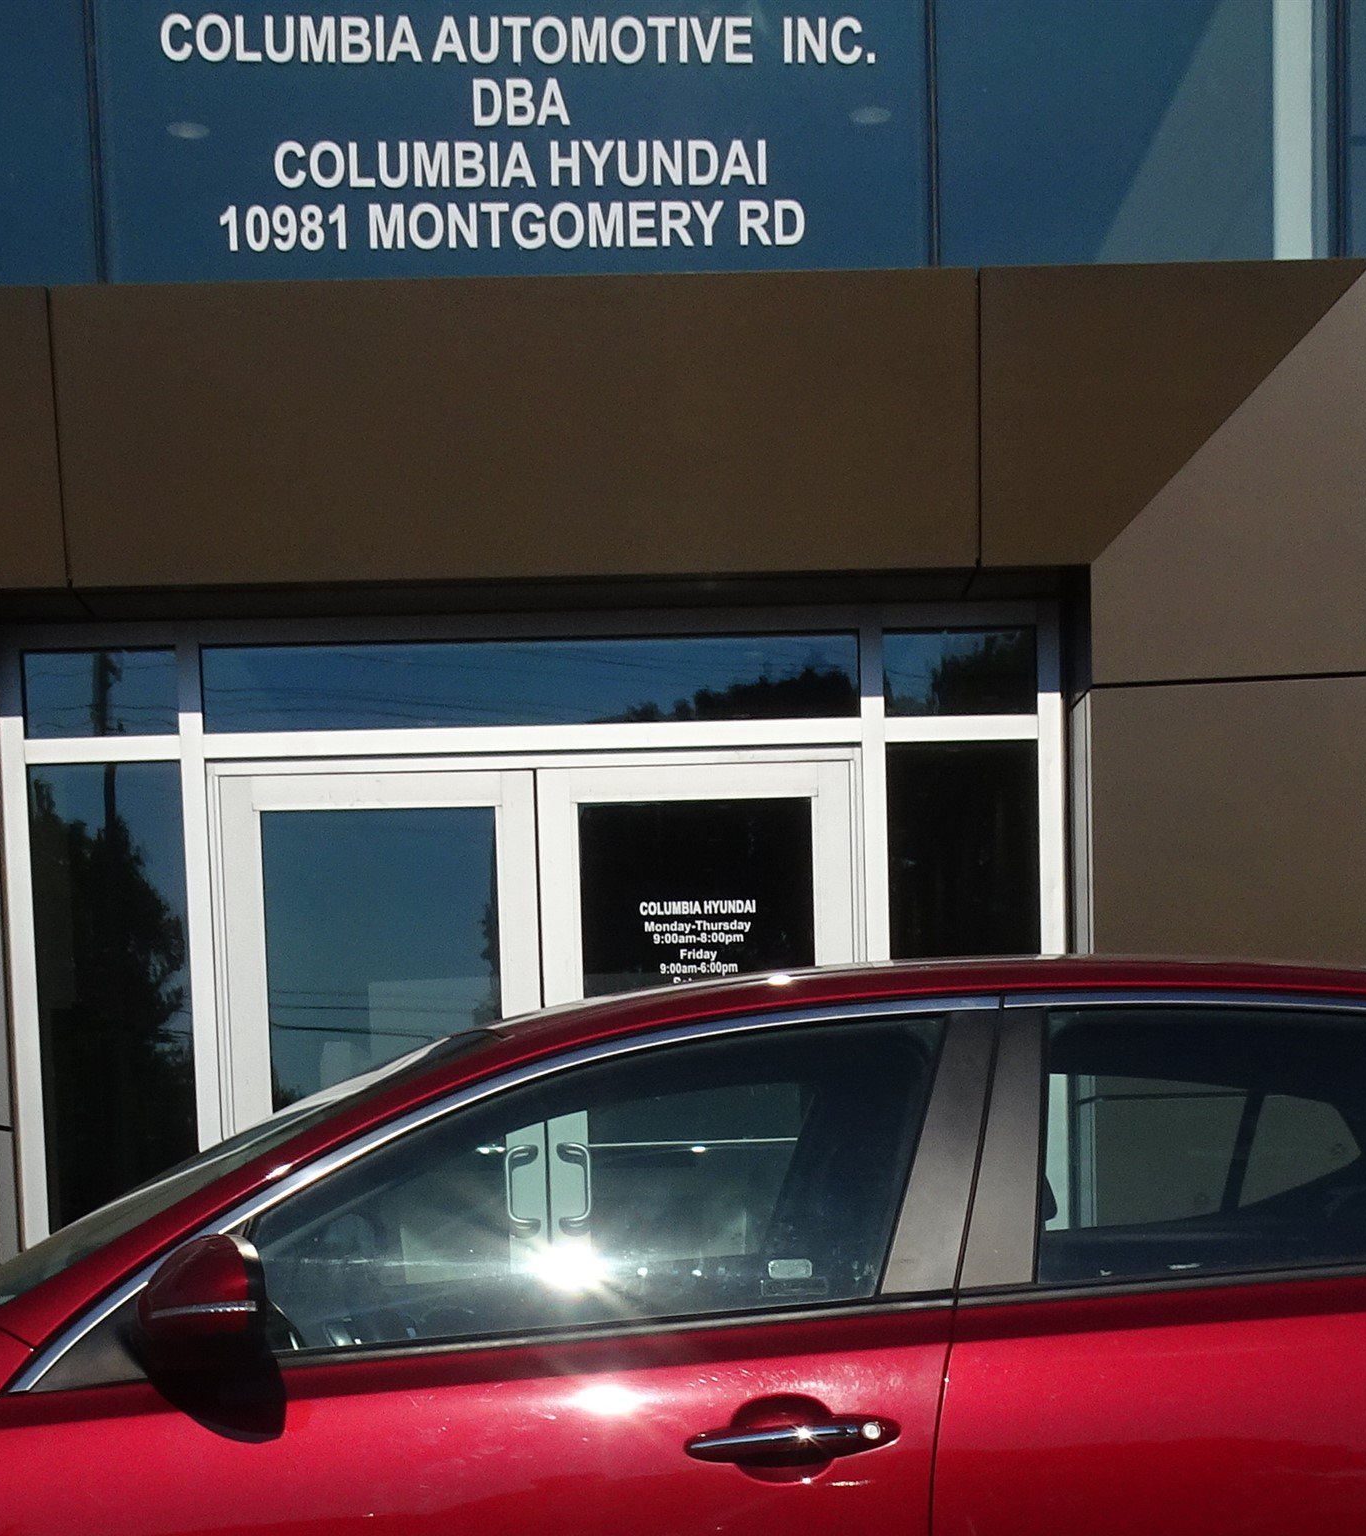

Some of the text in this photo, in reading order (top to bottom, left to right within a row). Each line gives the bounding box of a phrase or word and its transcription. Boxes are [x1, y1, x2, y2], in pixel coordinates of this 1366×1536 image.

[160, 13, 877, 65] COLUMBIA AUTOMOTIVE INC.
[472, 77, 571, 127] DBA
[274, 139, 768, 189] COLUMBIA HYUNDAI
[219, 198, 806, 253] 10981 MONTGOMERY RD
[639, 899, 756, 916] COLUMBIA HYUNDAI
[644, 919, 751, 933] Monday-Thursday
[653, 932, 744, 945] 9:00am-8:00pm
[679, 948, 717, 961] Friday
[659, 961, 738, 976] 9:00am-6:00pm
